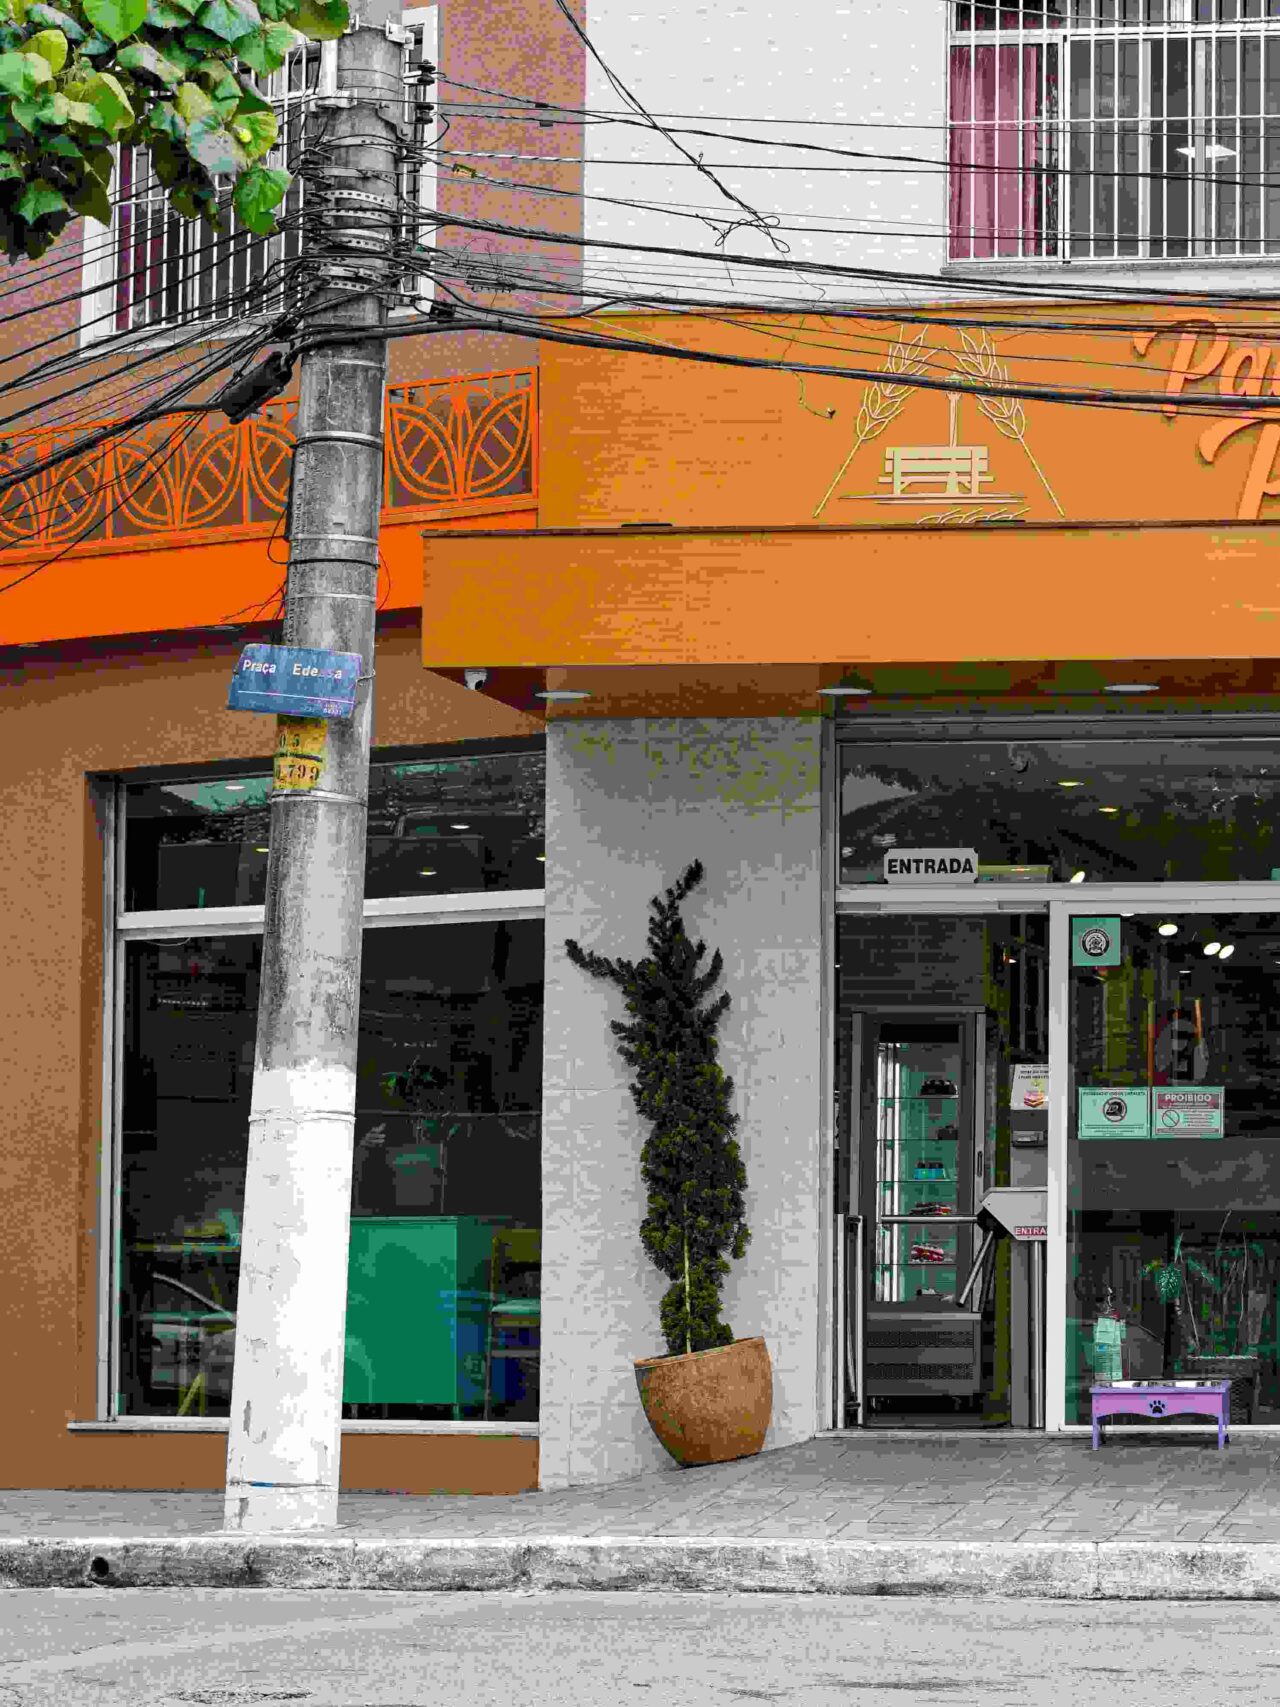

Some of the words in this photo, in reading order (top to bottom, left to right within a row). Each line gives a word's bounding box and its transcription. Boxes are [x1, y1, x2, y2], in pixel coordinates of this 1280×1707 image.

[243, 659, 277, 675] Praça
[292, 662, 343, 680] Edea
[887, 858, 974, 874] ENTRADA
[1164, 1094, 1212, 1102] PROIBIDO
